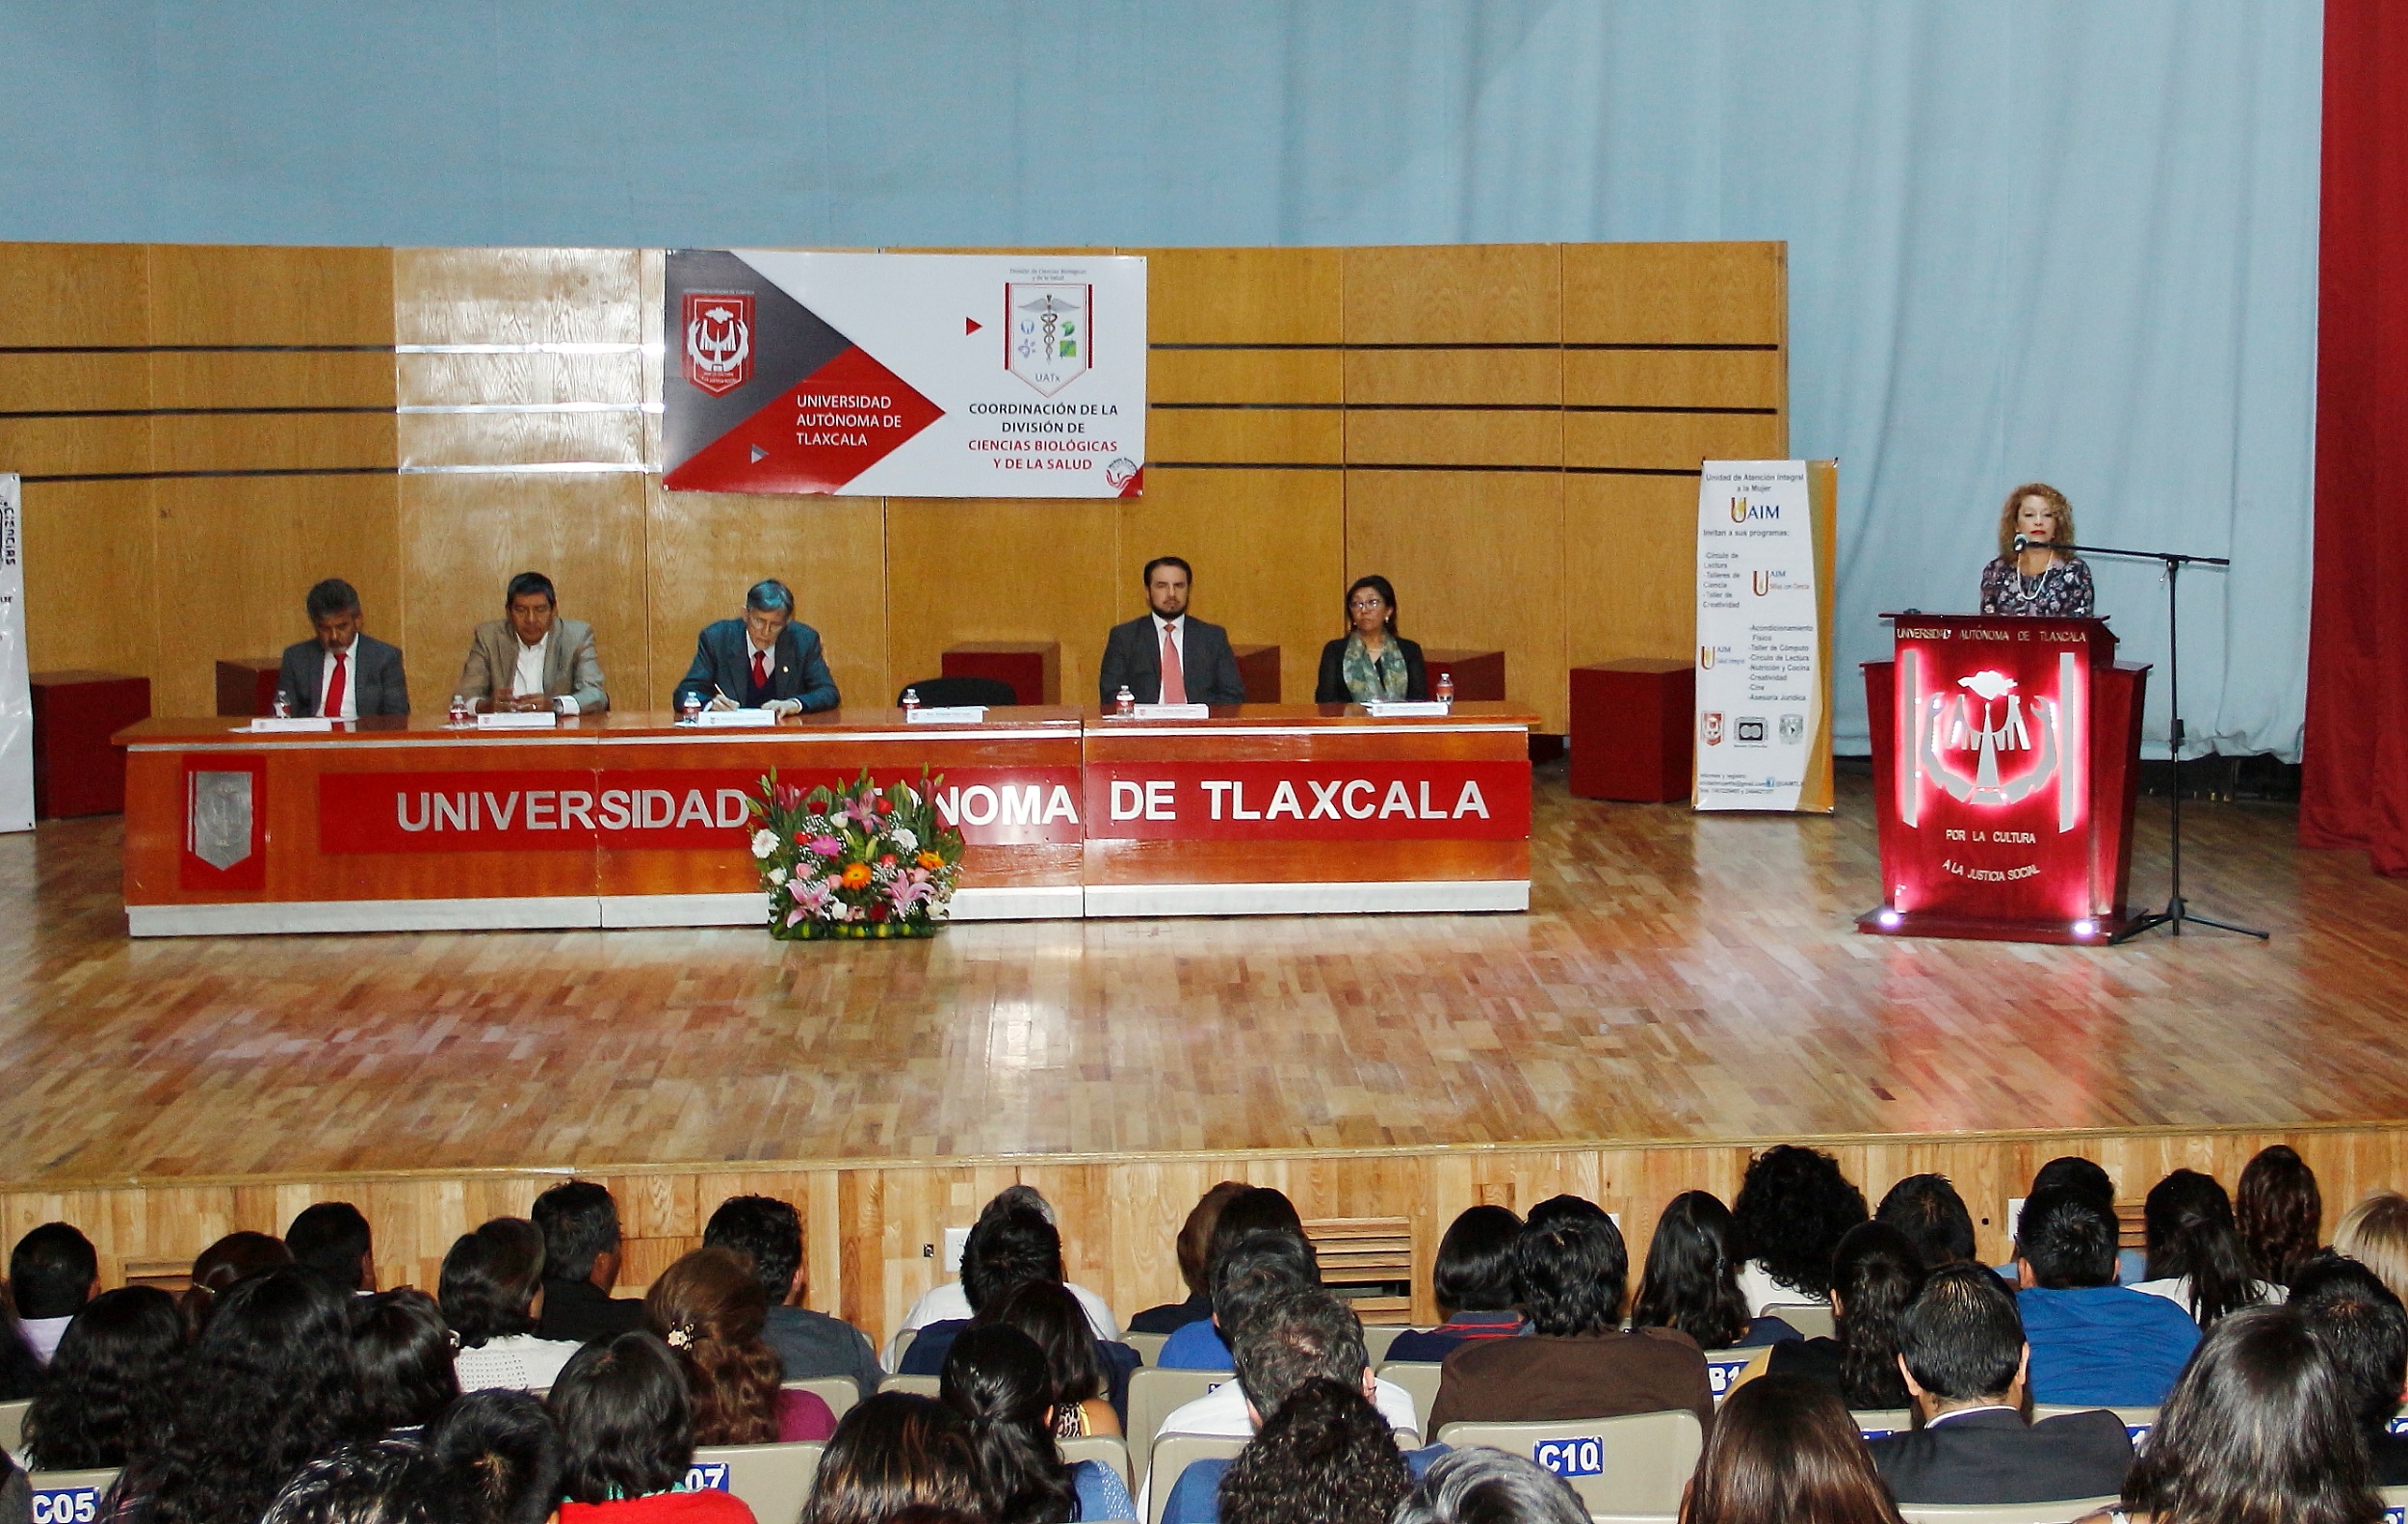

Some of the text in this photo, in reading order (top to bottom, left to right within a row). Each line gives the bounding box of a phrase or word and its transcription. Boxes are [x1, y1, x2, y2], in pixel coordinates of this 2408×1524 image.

[1035, 373, 1060, 382] UATx
[797, 394, 892, 409] UNIVERSIDAD
[969, 402, 1118, 415] COORDINACIÓN DE LA
[797, 411, 903, 428] AUTÓNOMA DE
[1002, 420, 1086, 434] DIVISIÓN DE
[796, 432, 868, 446] TLAXCALA
[968, 438, 1118, 452] CIENCIAS BIOLÓGICAS
[993, 458, 1092, 470] Y DE LA SALUD
[1897, 624, 2086, 643] UNIVERSIDAD AUTÓNOMA DE TLAXCALA
[397, 789, 751, 831] UNIVERSIDAD
[1110, 779, 1176, 821] DE
[1200, 778, 1491, 821] TLAXCALA
[1946, 829, 2036, 844] POR LA CULTURA
[1942, 858, 2041, 881] A LA JUSTICIA SOCIAL
[1538, 1441, 1599, 1473] C10
[685, 1468, 726, 1492] 07
[32, 1492, 96, 1524] C05
